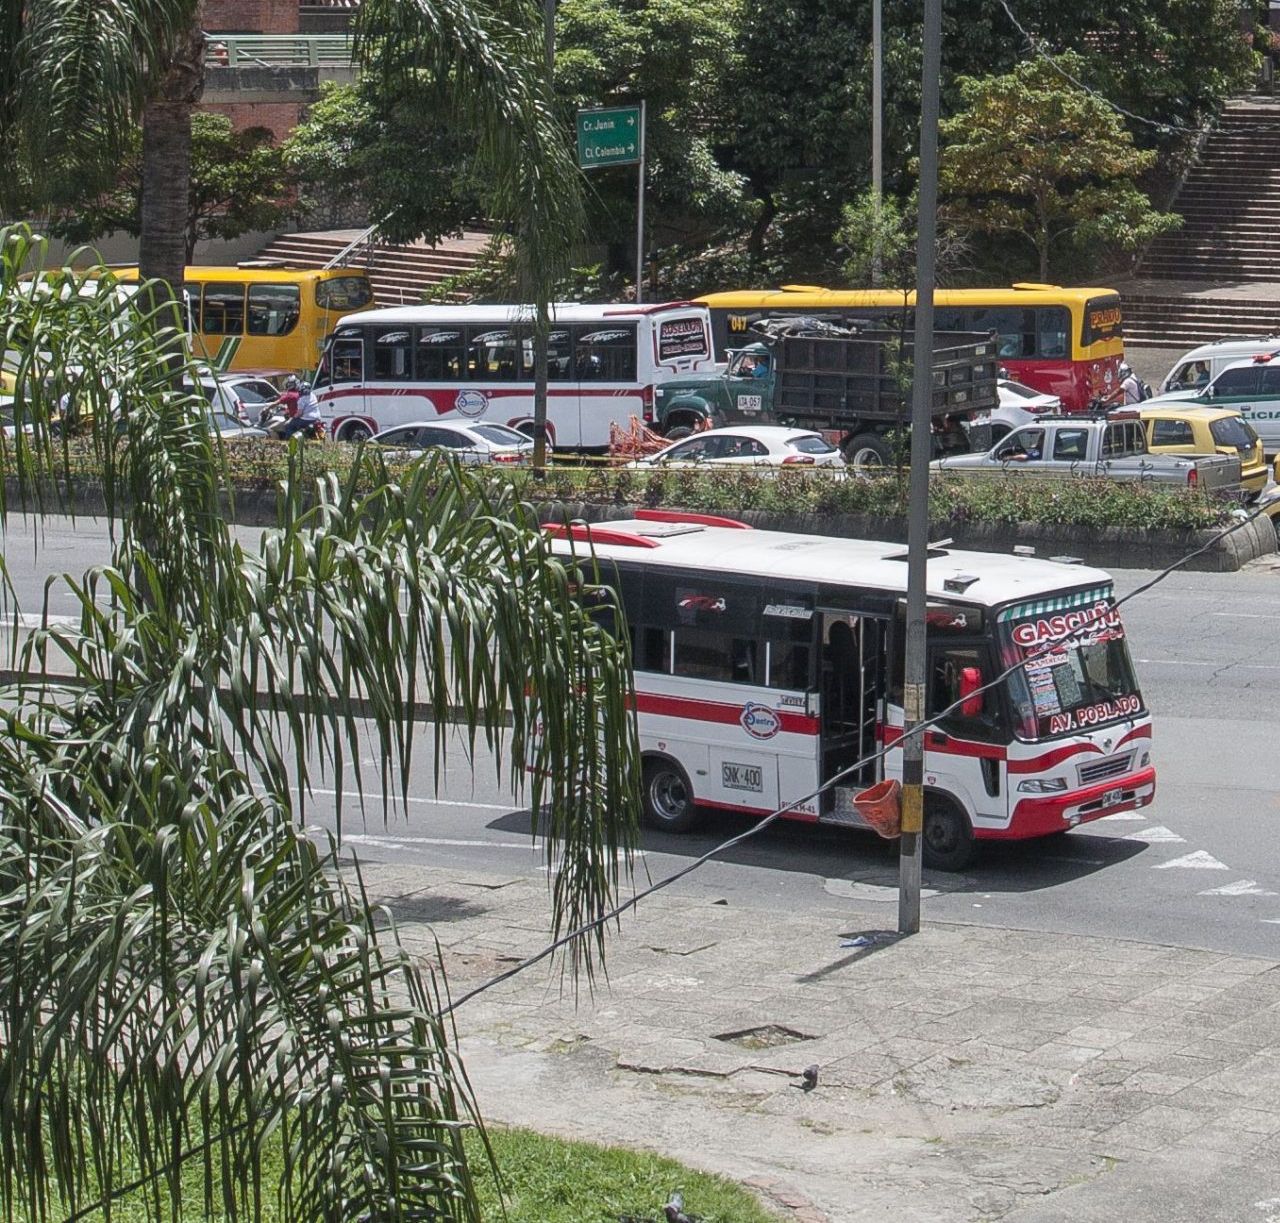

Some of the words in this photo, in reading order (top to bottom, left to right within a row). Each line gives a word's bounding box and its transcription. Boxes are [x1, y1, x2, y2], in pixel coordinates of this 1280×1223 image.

[595, 144, 626, 157] Colombia
[1012, 600, 1121, 648] GASCUÑA
[1050, 713, 1077, 733] AV.
[1076, 696, 1141, 726] POBLADO
